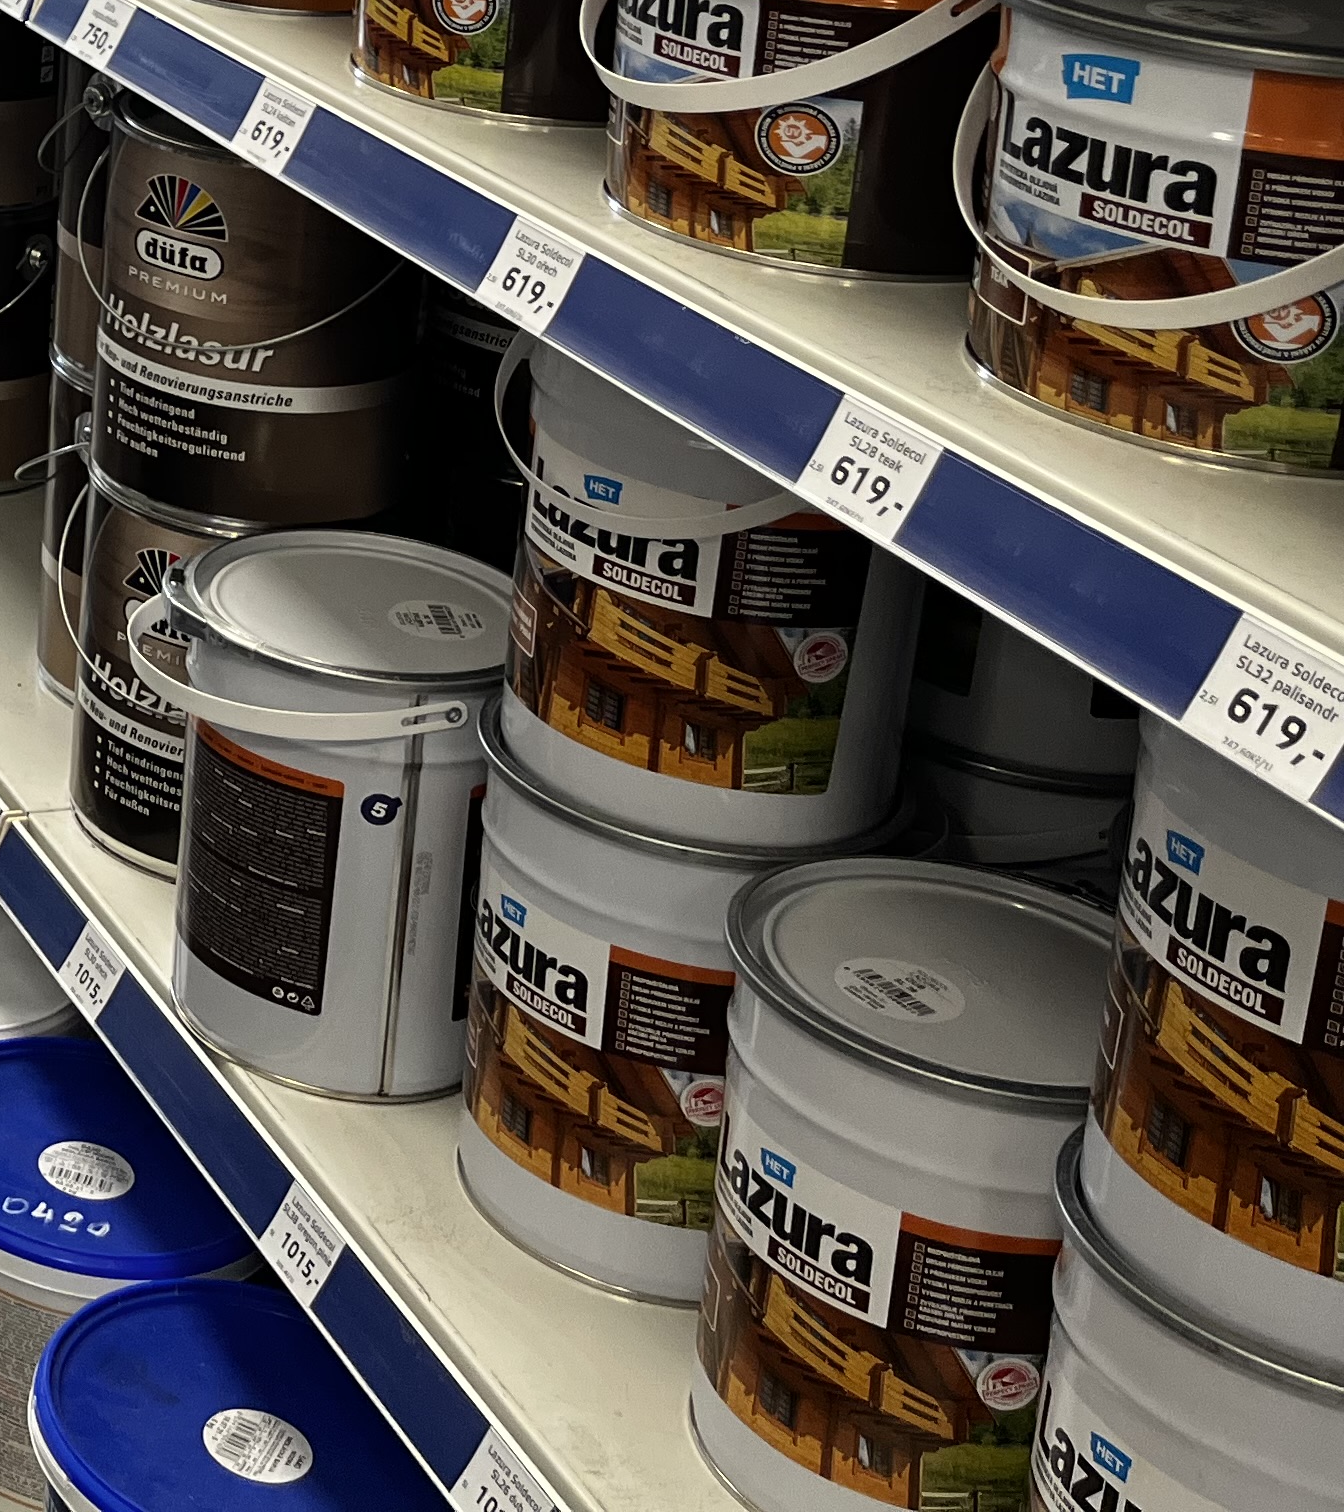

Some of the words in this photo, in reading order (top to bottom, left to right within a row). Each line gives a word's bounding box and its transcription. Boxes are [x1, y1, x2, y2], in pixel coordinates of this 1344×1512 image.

[81, 21, 116, 53] 750,-
[661, 37, 728, 72] SOLDECOL
[1073, 64, 1125, 96] HET
[1000, 100, 1218, 219] Lazura
[1093, 200, 1195, 241] SOLDECOL
[144, 238, 208, 274] düfa
[515, 229, 540, 254] Lazura
[541, 241, 574, 270] Soldecol
[515, 247, 536, 266] SL30
[128, 265, 228, 305] PREMIUM
[502, 266, 554, 316] 619,-
[105, 292, 275, 373] Holzlasur
[139, 365, 293, 408] Renovierungsanstriche
[844, 411, 879, 440] Lazura
[880, 429, 928, 467] Soldecol
[848, 435, 878, 461] SL28
[879, 451, 904, 474] teak
[589, 479, 617, 500] HET
[829, 455, 905, 518] 619,-
[601, 562, 686, 604] SOLDECOL
[1236, 655, 1274, 685] SL32
[1272, 680, 1339, 724] palisandr
[1243, 634, 1290, 671] Lazura
[1291, 662, 1344, 704] Soldeco
[1227, 687, 1326, 766] 619,-
[370, 800, 388, 819] 5
[1169, 833, 1202, 871] HET
[74, 961, 104, 1006] 1015,-
[1175, 946, 1271, 1018] SOLDECOL
[512, 980, 580, 1031] SOLDECOL
[763, 1152, 796, 1185] HET
[280, 1230, 320, 1290] 1015,-
[775, 1244, 858, 1306] SOLDECOL
